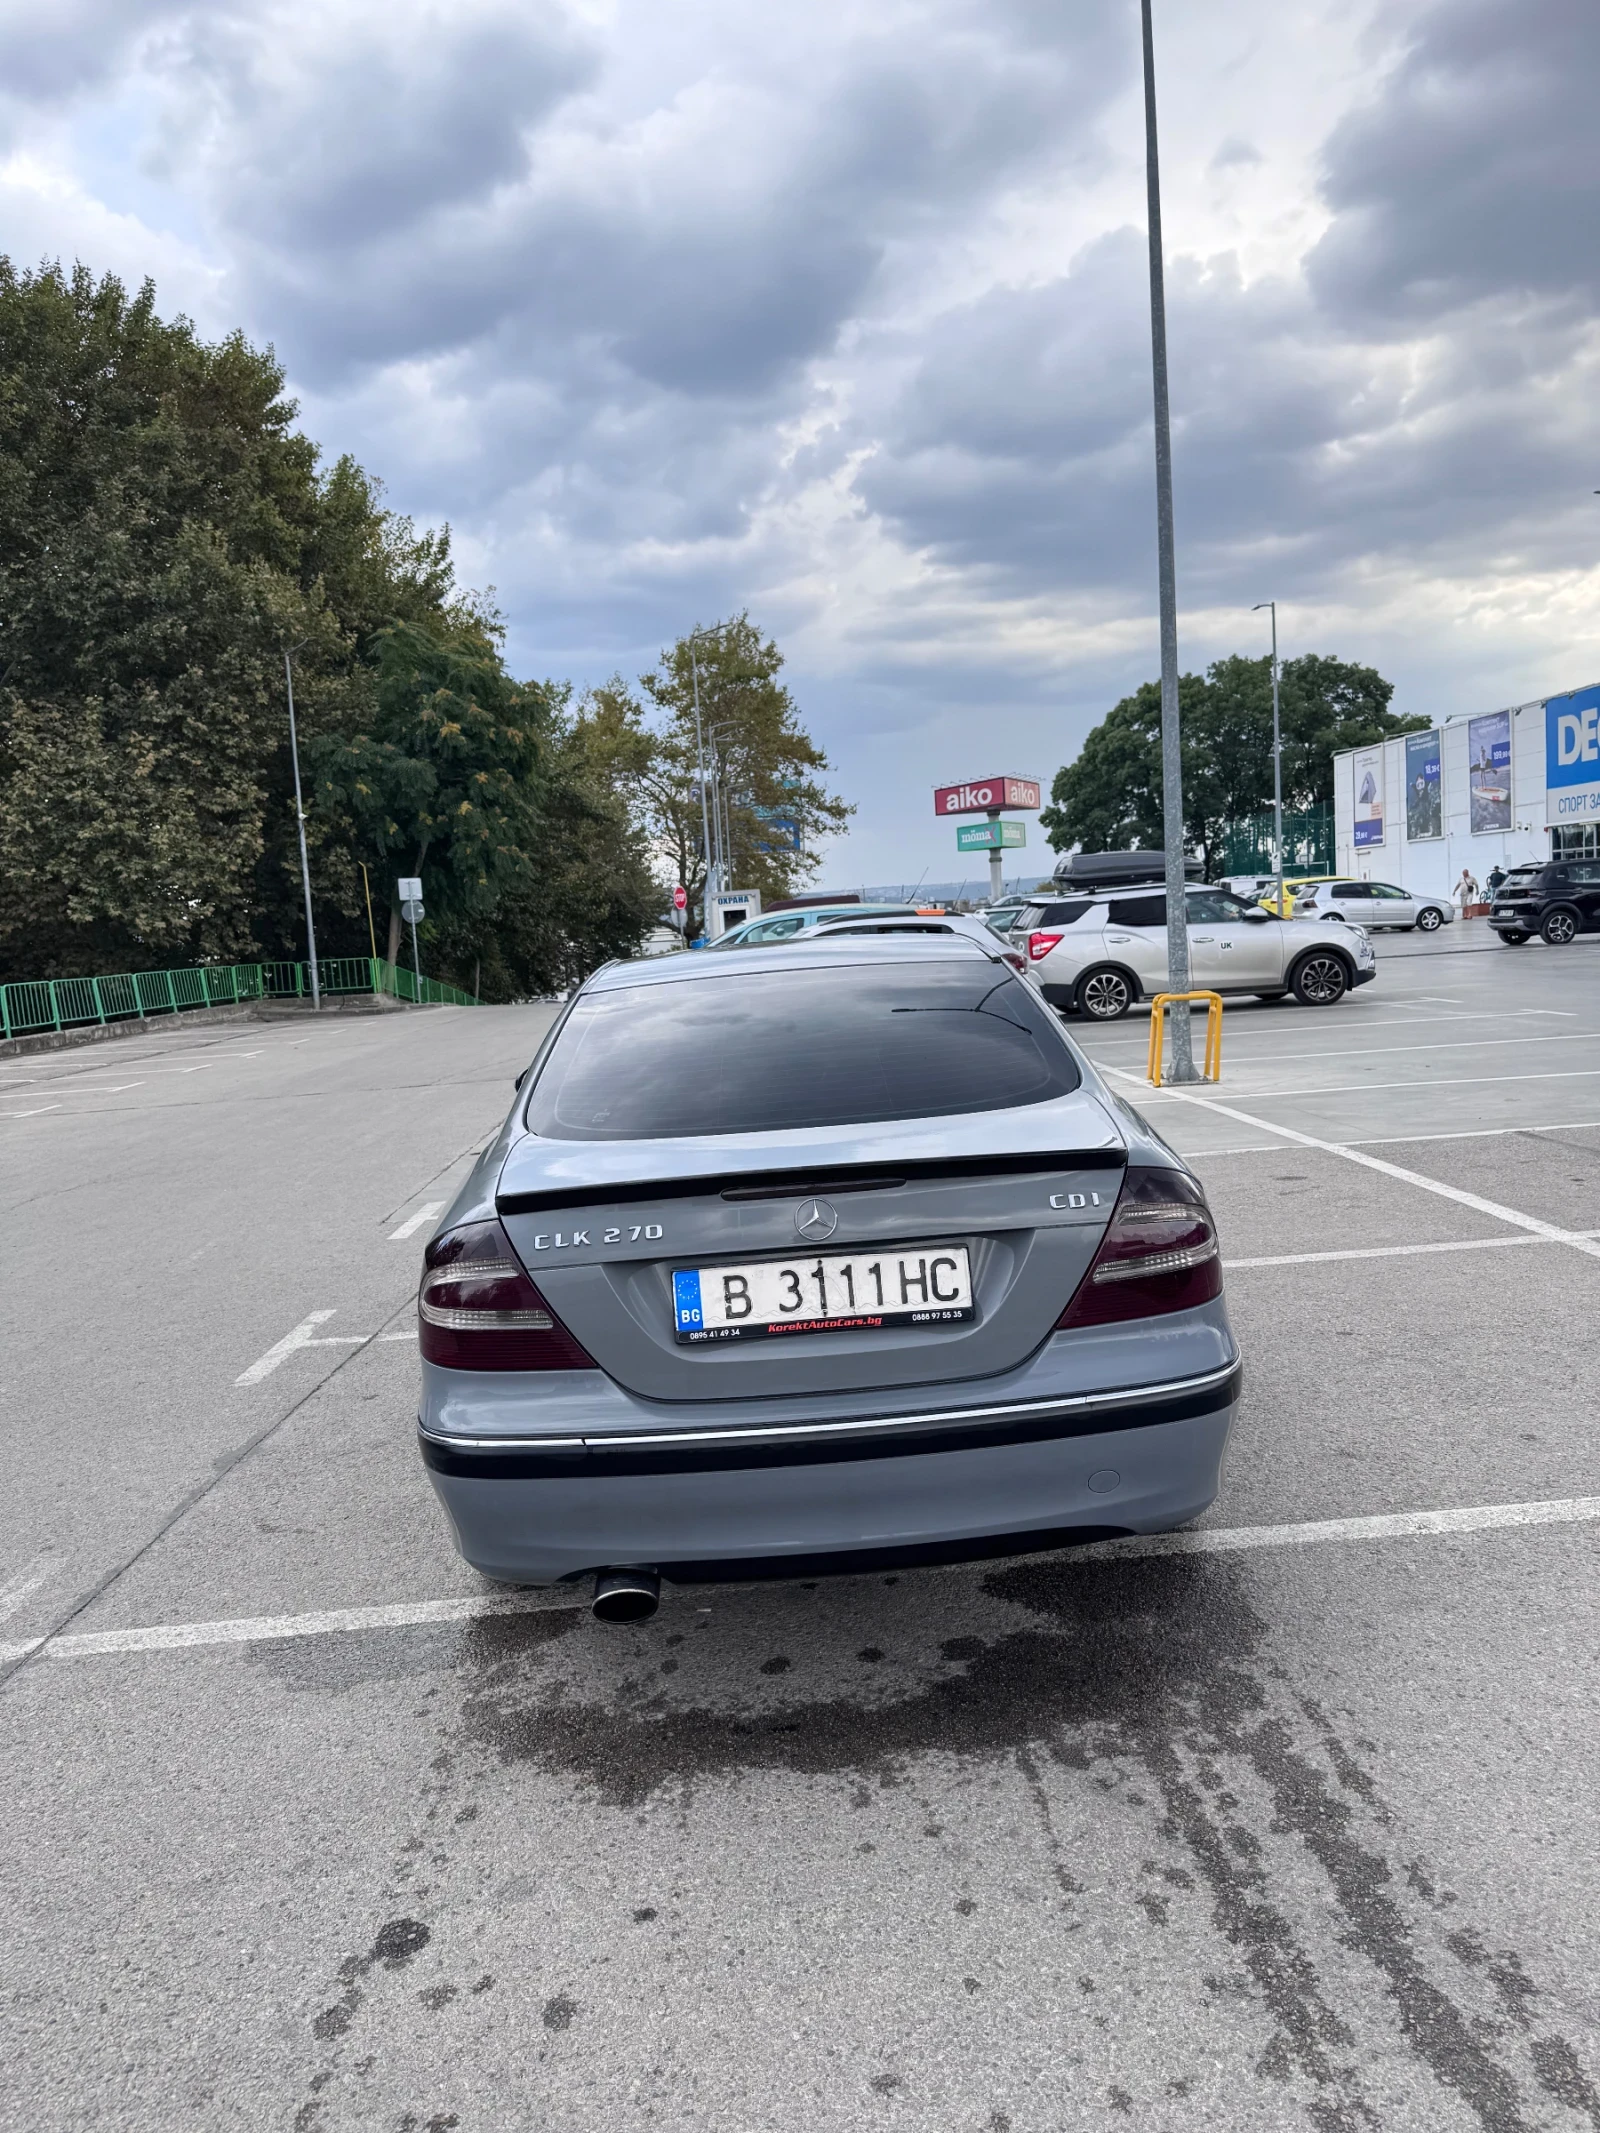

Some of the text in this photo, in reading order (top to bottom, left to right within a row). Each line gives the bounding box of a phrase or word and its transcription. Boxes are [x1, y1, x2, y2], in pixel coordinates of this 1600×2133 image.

[1557, 706, 1600, 766] DE
[946, 786, 993, 811] aiko
[1010, 783, 1035, 804] aiko
[1558, 794, 1588, 814] СПОРТ
[718, 895, 750, 906] ОХРАНА
[1220, 942, 1232, 950] UK
[1049, 1192, 1100, 1209] CDI
[534, 1224, 663, 1251] CLK 270
[723, 1275, 752, 1319] B
[681, 1309, 700, 1323] BG
[768, 1316, 883, 1333] KorektAutoCars.bg
